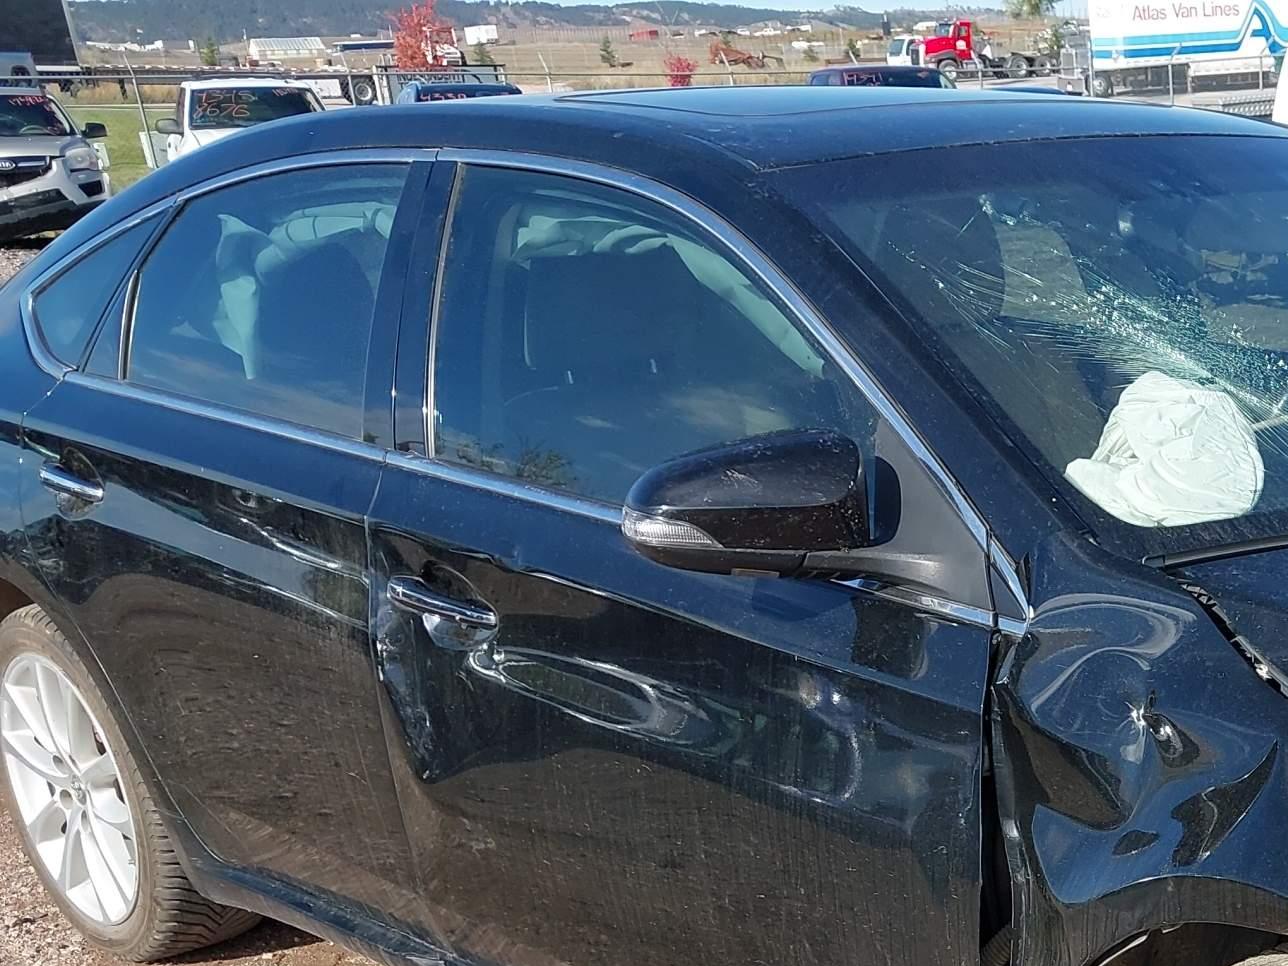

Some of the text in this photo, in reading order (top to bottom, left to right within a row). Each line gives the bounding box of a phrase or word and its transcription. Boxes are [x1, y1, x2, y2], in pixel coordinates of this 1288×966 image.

[1132, 1, 1240, 21] Atlas Van Lines
